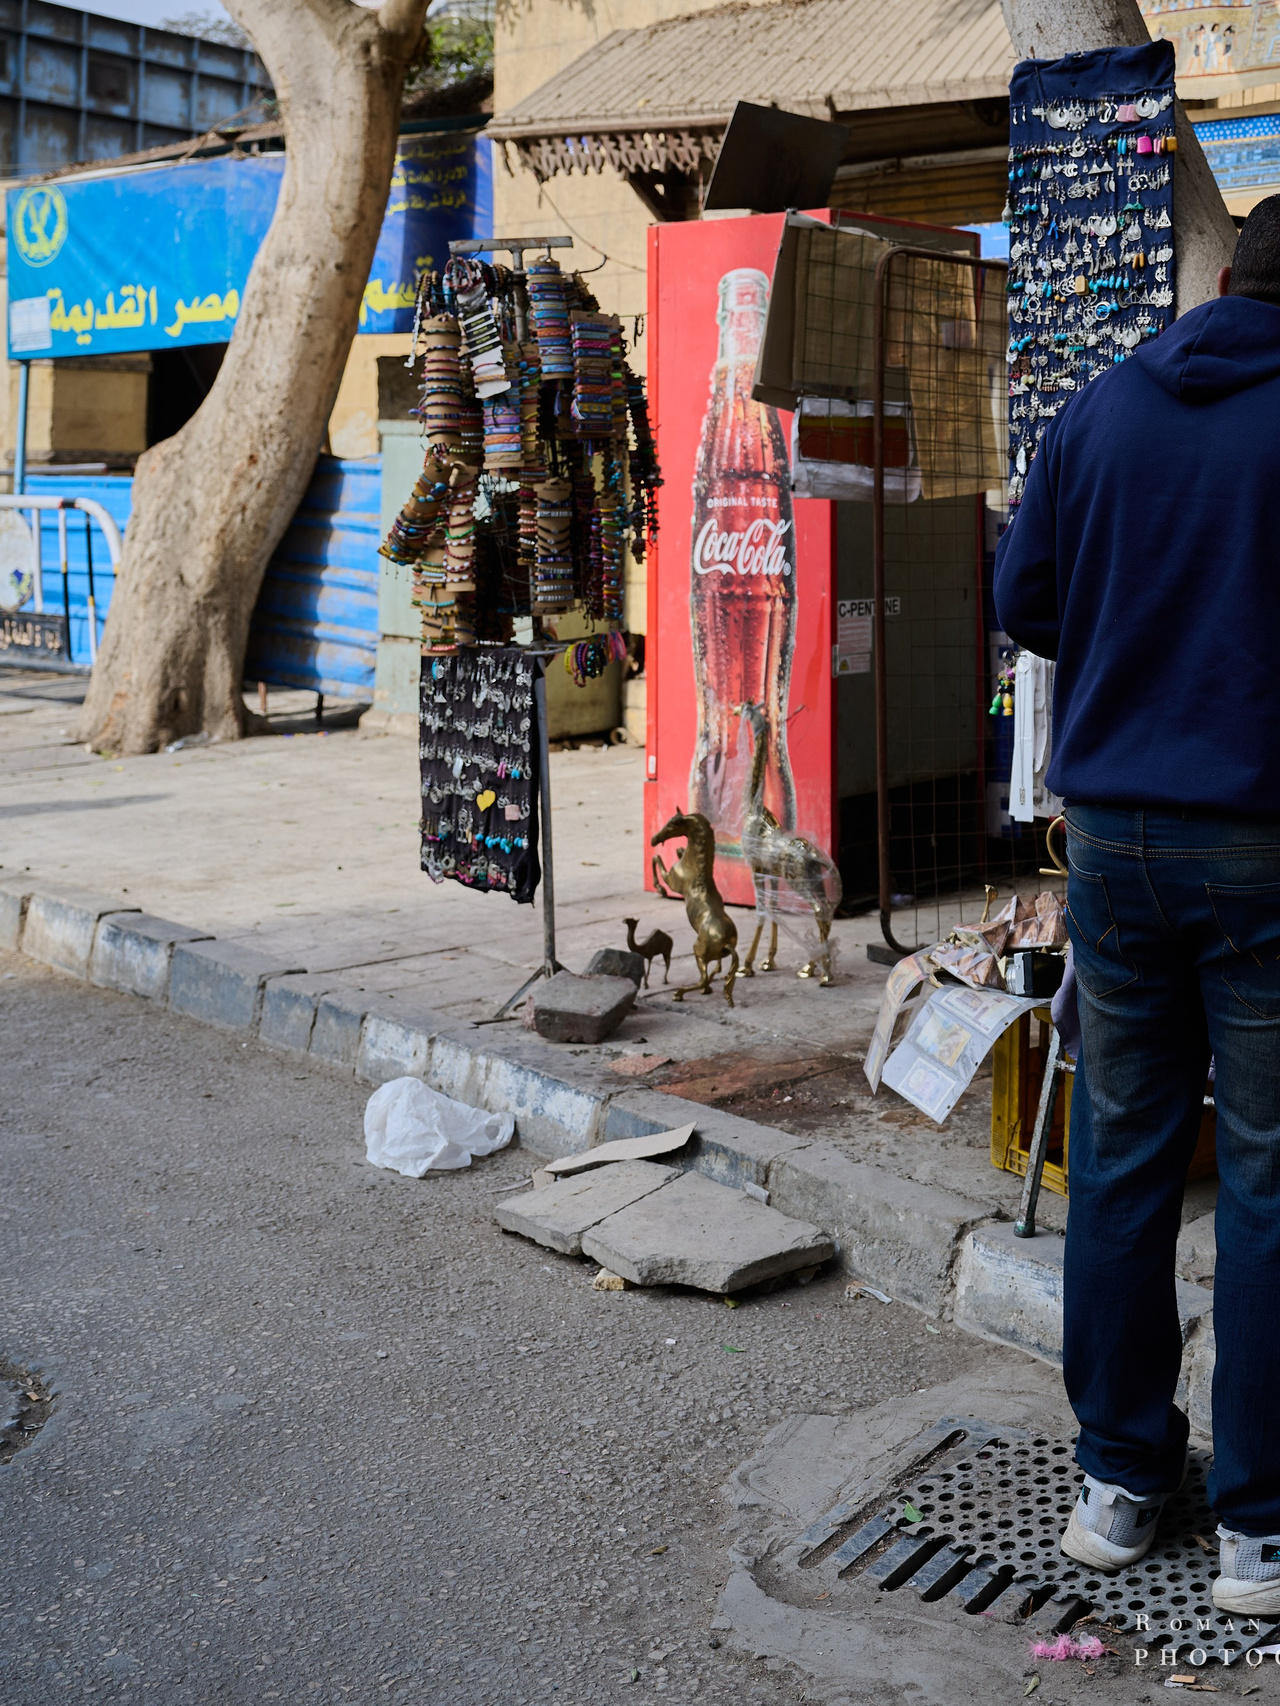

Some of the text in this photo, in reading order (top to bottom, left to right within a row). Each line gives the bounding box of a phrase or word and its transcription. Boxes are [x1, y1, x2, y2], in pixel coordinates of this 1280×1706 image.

[46, 284, 157, 345] القديمة
[164, 289, 239, 337] مصر
[706, 496, 778, 509] ORIGINAL TASTE
[694, 518, 792, 576] Coca-Cola
